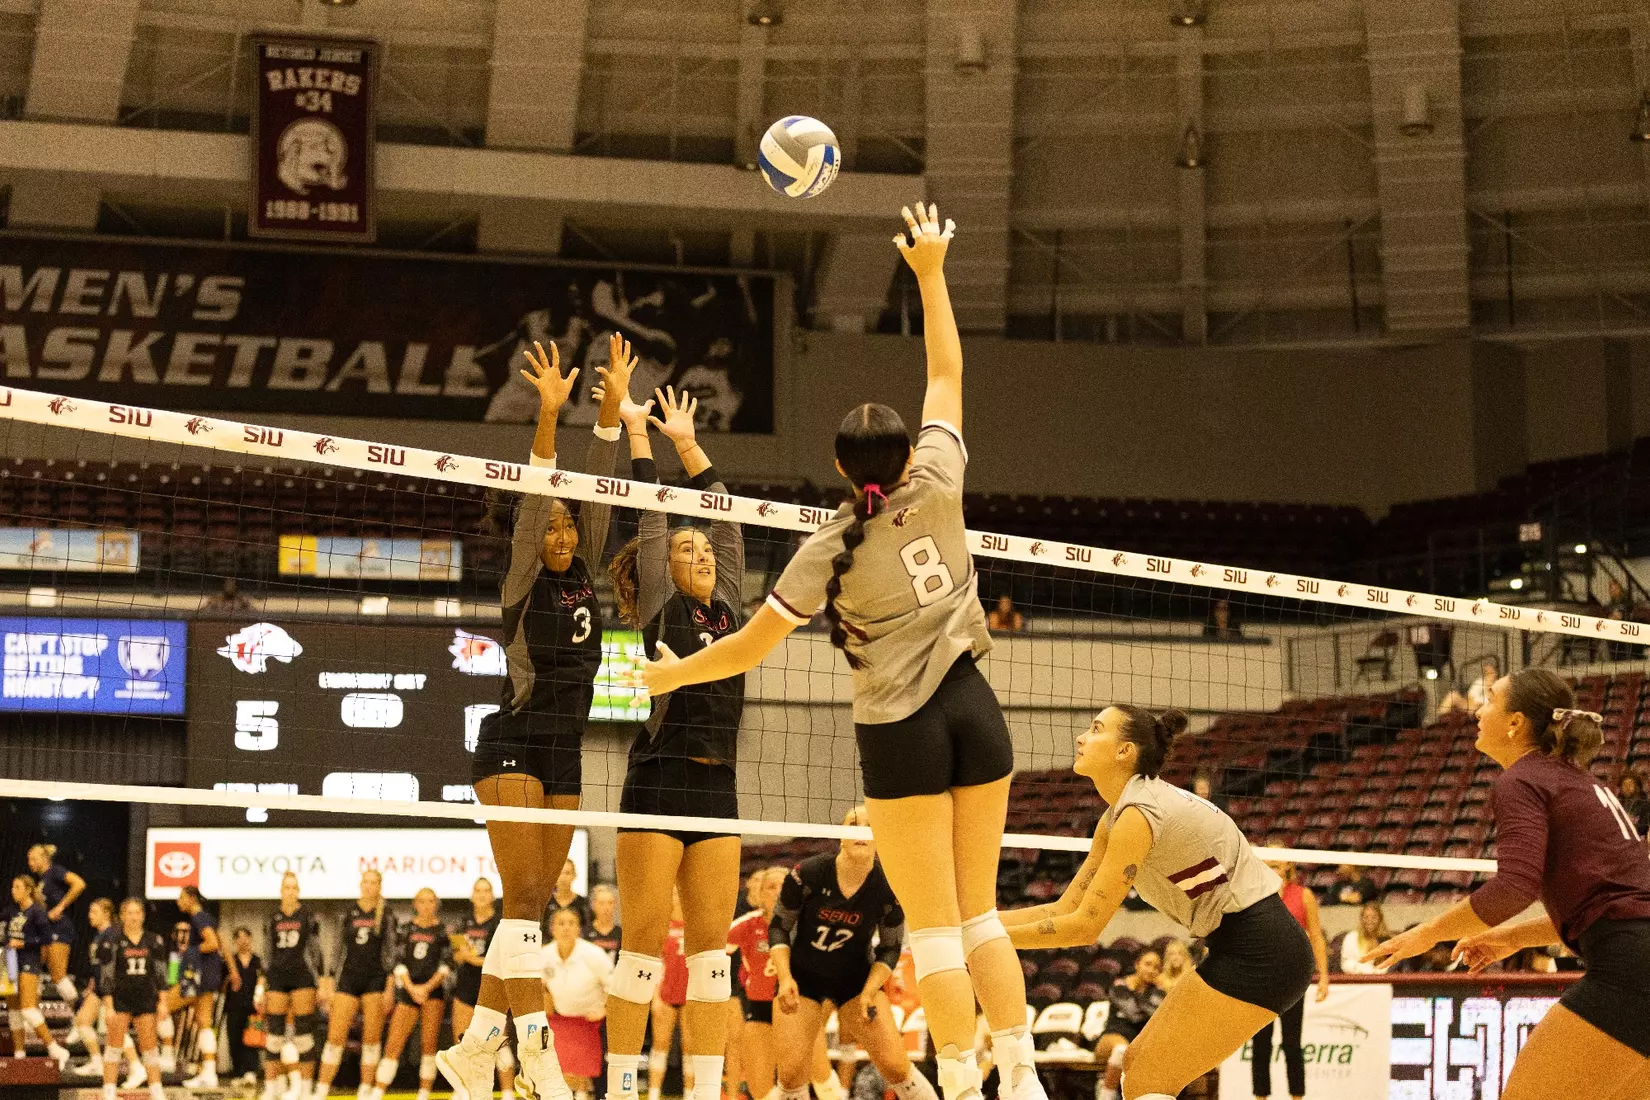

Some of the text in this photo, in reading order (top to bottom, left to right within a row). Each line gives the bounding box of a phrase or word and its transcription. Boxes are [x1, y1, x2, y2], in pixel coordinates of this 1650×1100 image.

[266, 68, 361, 96] RAKERS
[109, 405, 1640, 637] SIU SIU SIU SIU SIU SIU SIU SIU SIU SIU SIU SIU SIU SIU SIU SIU SIU
[899, 534, 955, 608] 8
[571, 606, 592, 644] 3
[234, 700, 279, 751] 5
[217, 855, 326, 875] TOYOTA
[358, 856, 467, 874] MARION
[810, 925, 854, 952] 12
